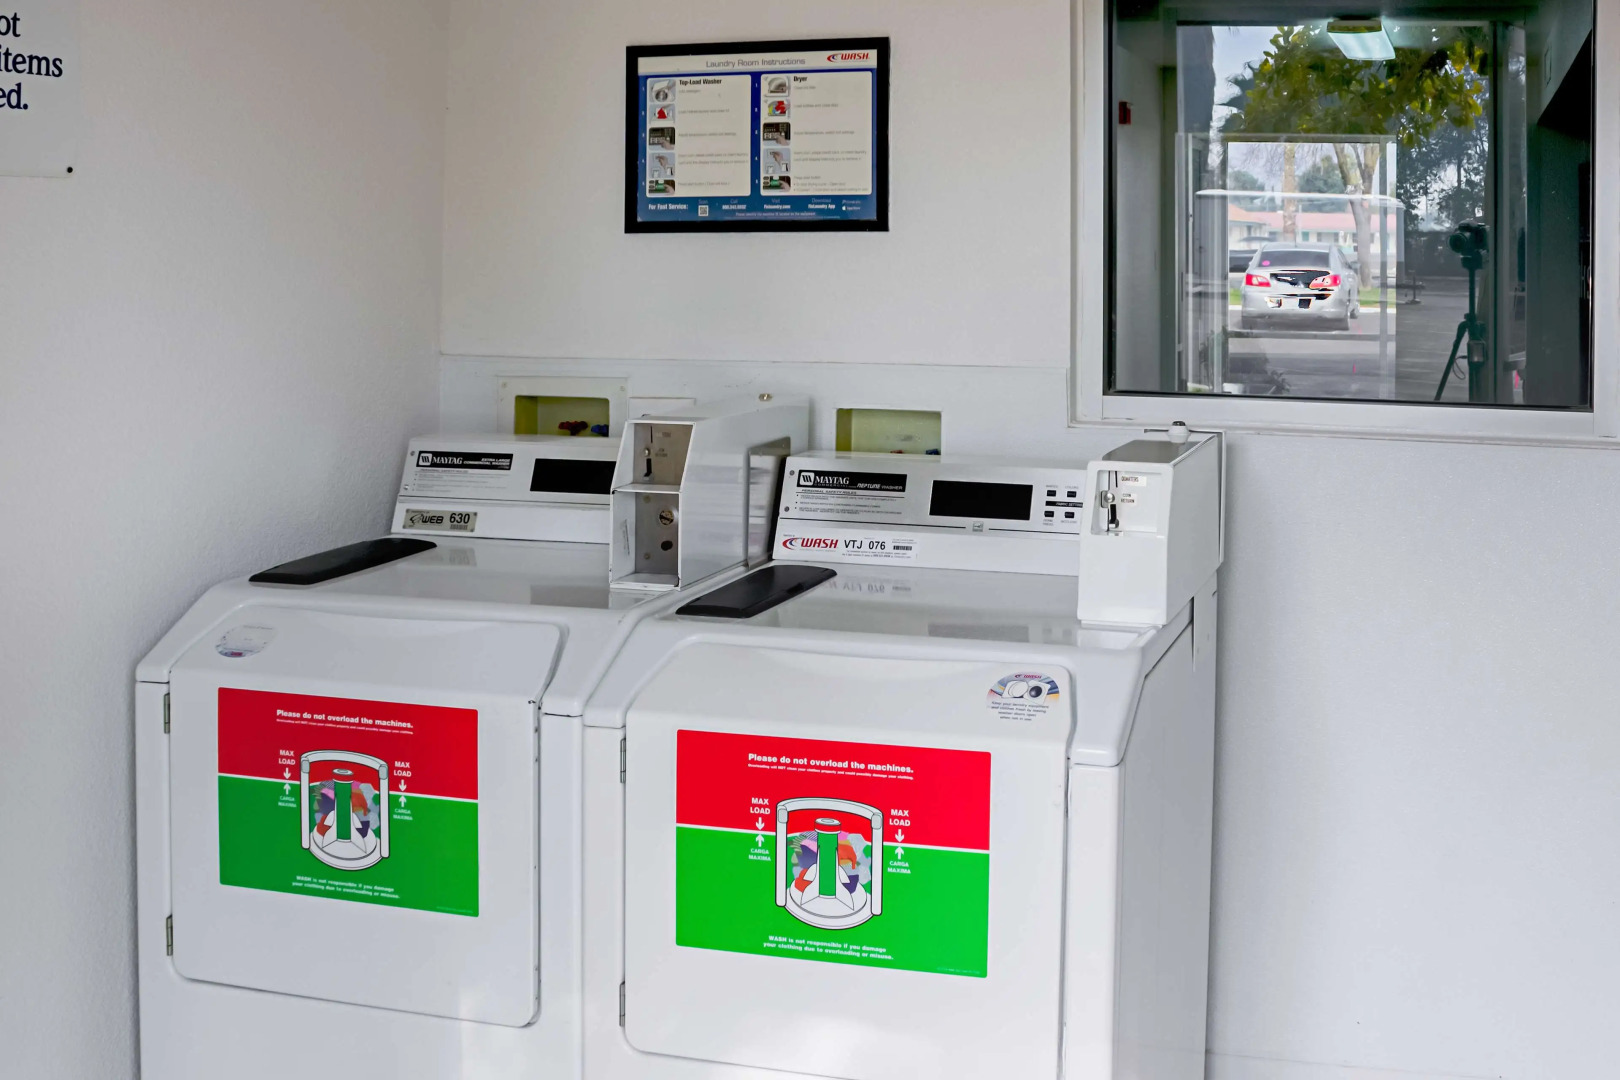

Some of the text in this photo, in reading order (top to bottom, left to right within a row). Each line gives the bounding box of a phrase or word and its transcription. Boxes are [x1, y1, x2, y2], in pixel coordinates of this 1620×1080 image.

[0, 12, 20, 38] ot
[432, 456, 463, 464] MAYTAG
[815, 476, 849, 485] MAYTAG
[422, 513, 470, 524] WEB 630
[801, 538, 838, 548] WASH
[844, 540, 862, 549] VTJ
[868, 541, 885, 550] 076
[276, 709, 300, 718] Please
[375, 720, 413, 728] machines.
[748, 753, 778, 762] Please
[810, 759, 848, 768] overload
[851, 761, 865, 769] the
[868, 764, 913, 773] machines.
[751, 797, 769, 805] MAX
[750, 806, 770, 815] LOAD
[890, 809, 909, 817] MAX
[889, 818, 910, 827] LOAD
[825, 949, 860, 957] overloading
